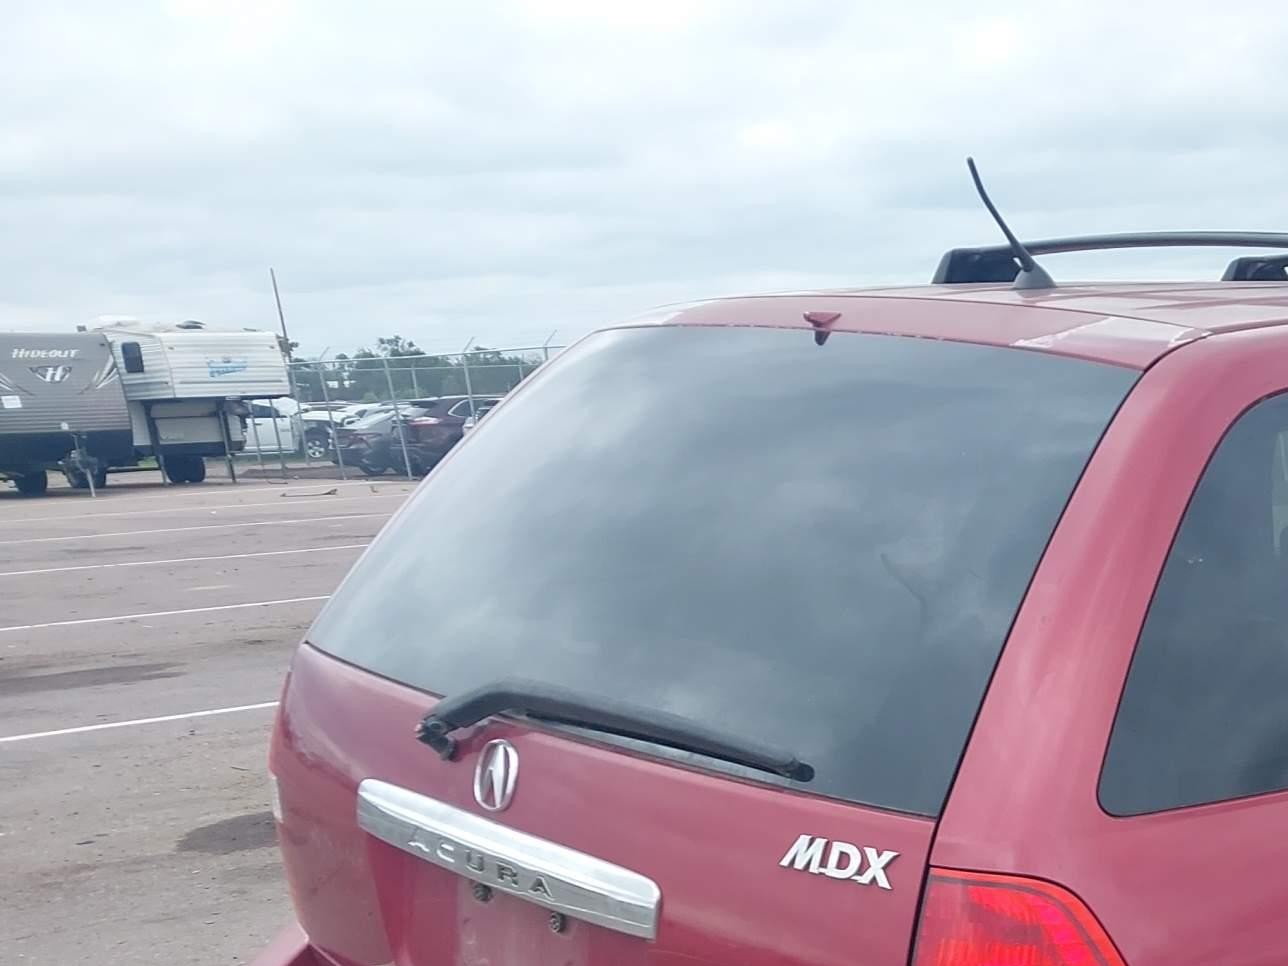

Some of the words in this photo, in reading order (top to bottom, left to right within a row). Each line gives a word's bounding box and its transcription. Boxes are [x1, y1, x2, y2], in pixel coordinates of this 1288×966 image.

[11, 348, 80, 358] HIDEOUT
[407, 827, 556, 901] ACURA
[779, 834, 901, 890] MDX
